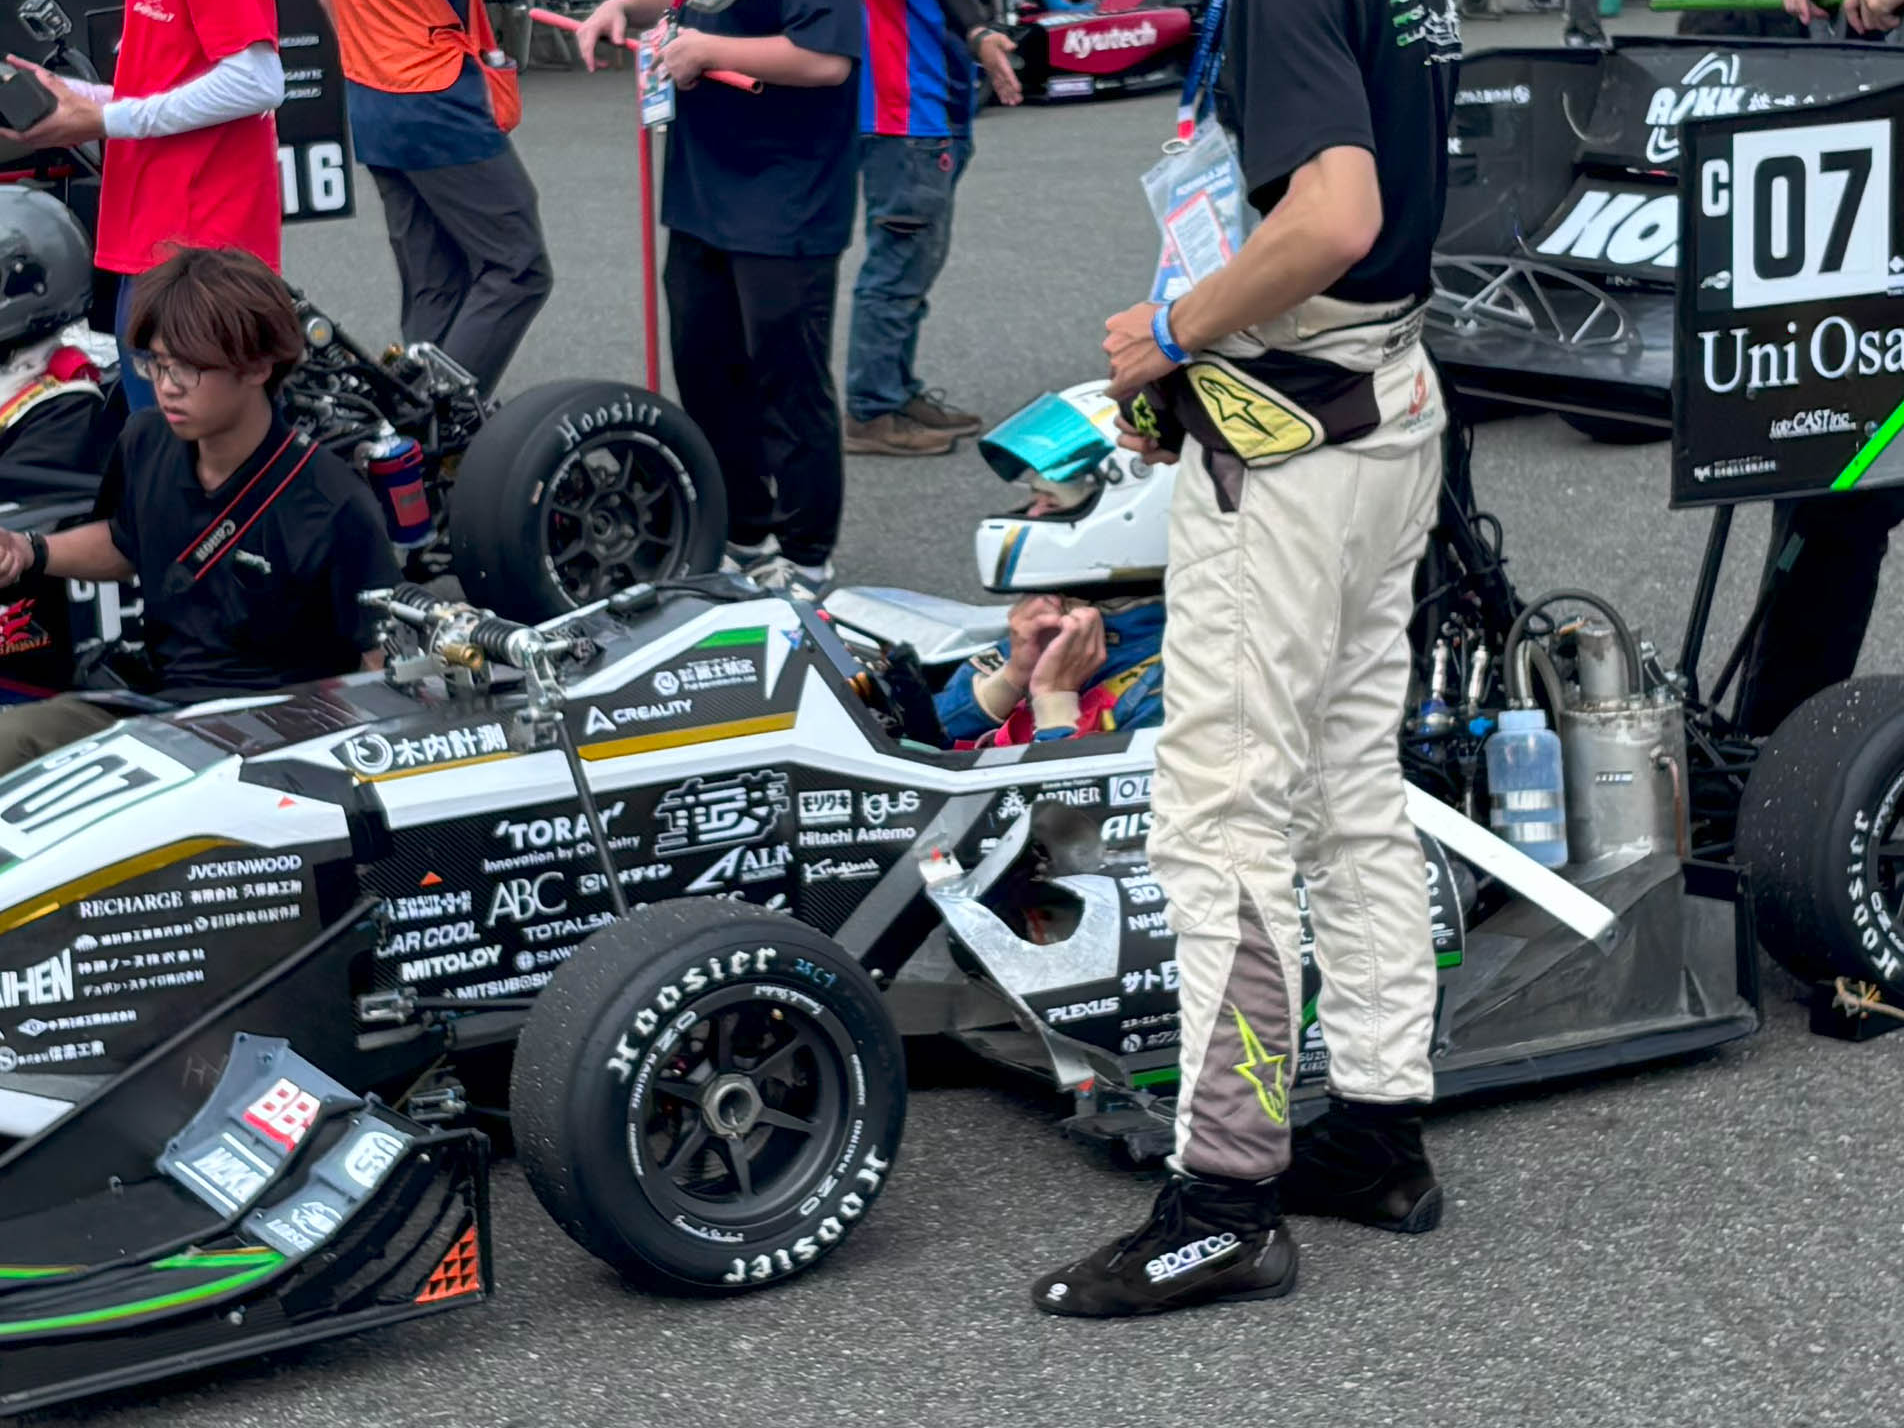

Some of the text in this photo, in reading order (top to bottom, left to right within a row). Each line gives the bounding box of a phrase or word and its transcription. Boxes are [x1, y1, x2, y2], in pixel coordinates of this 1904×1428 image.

[1062, 20, 1159, 60] Kyutech
[278, 141, 346, 214] 16
[1701, 158, 1730, 218] C
[1752, 148, 1874, 281] 07
[1698, 317, 1799, 395] Uni
[556, 392, 662, 452] Hoosier
[194, 518, 237, 563] Canon
[613, 698, 693, 724] CREALITY
[393, 722, 509, 767] 木内計測
[0, 753, 161, 834] 07
[862, 790, 921, 824] igus
[484, 835, 641, 873] Innovation by Chistry
[799, 826, 917, 847] Hitachi Astemo
[187, 854, 303, 883] JVCKENWOOD
[78, 890, 184, 920] RECHARGE
[485, 870, 568, 929] ABC
[1847, 809, 1901, 980] Hoosier
[423, 920, 481, 950] COOL
[401, 944, 503, 982] MITOLOY
[456, 971, 555, 1000] MITSUBOSH
[607, 946, 777, 1084] Hoosier
[657, 1009, 698, 1053] OZ
[1045, 996, 1121, 1024] PLEXUS
[1297, 1050, 1330, 1064] SUZU
[724, 1144, 889, 1284] Hoosier
[799, 1173, 839, 1217] OZ
[1146, 1231, 1238, 1279] sparco
